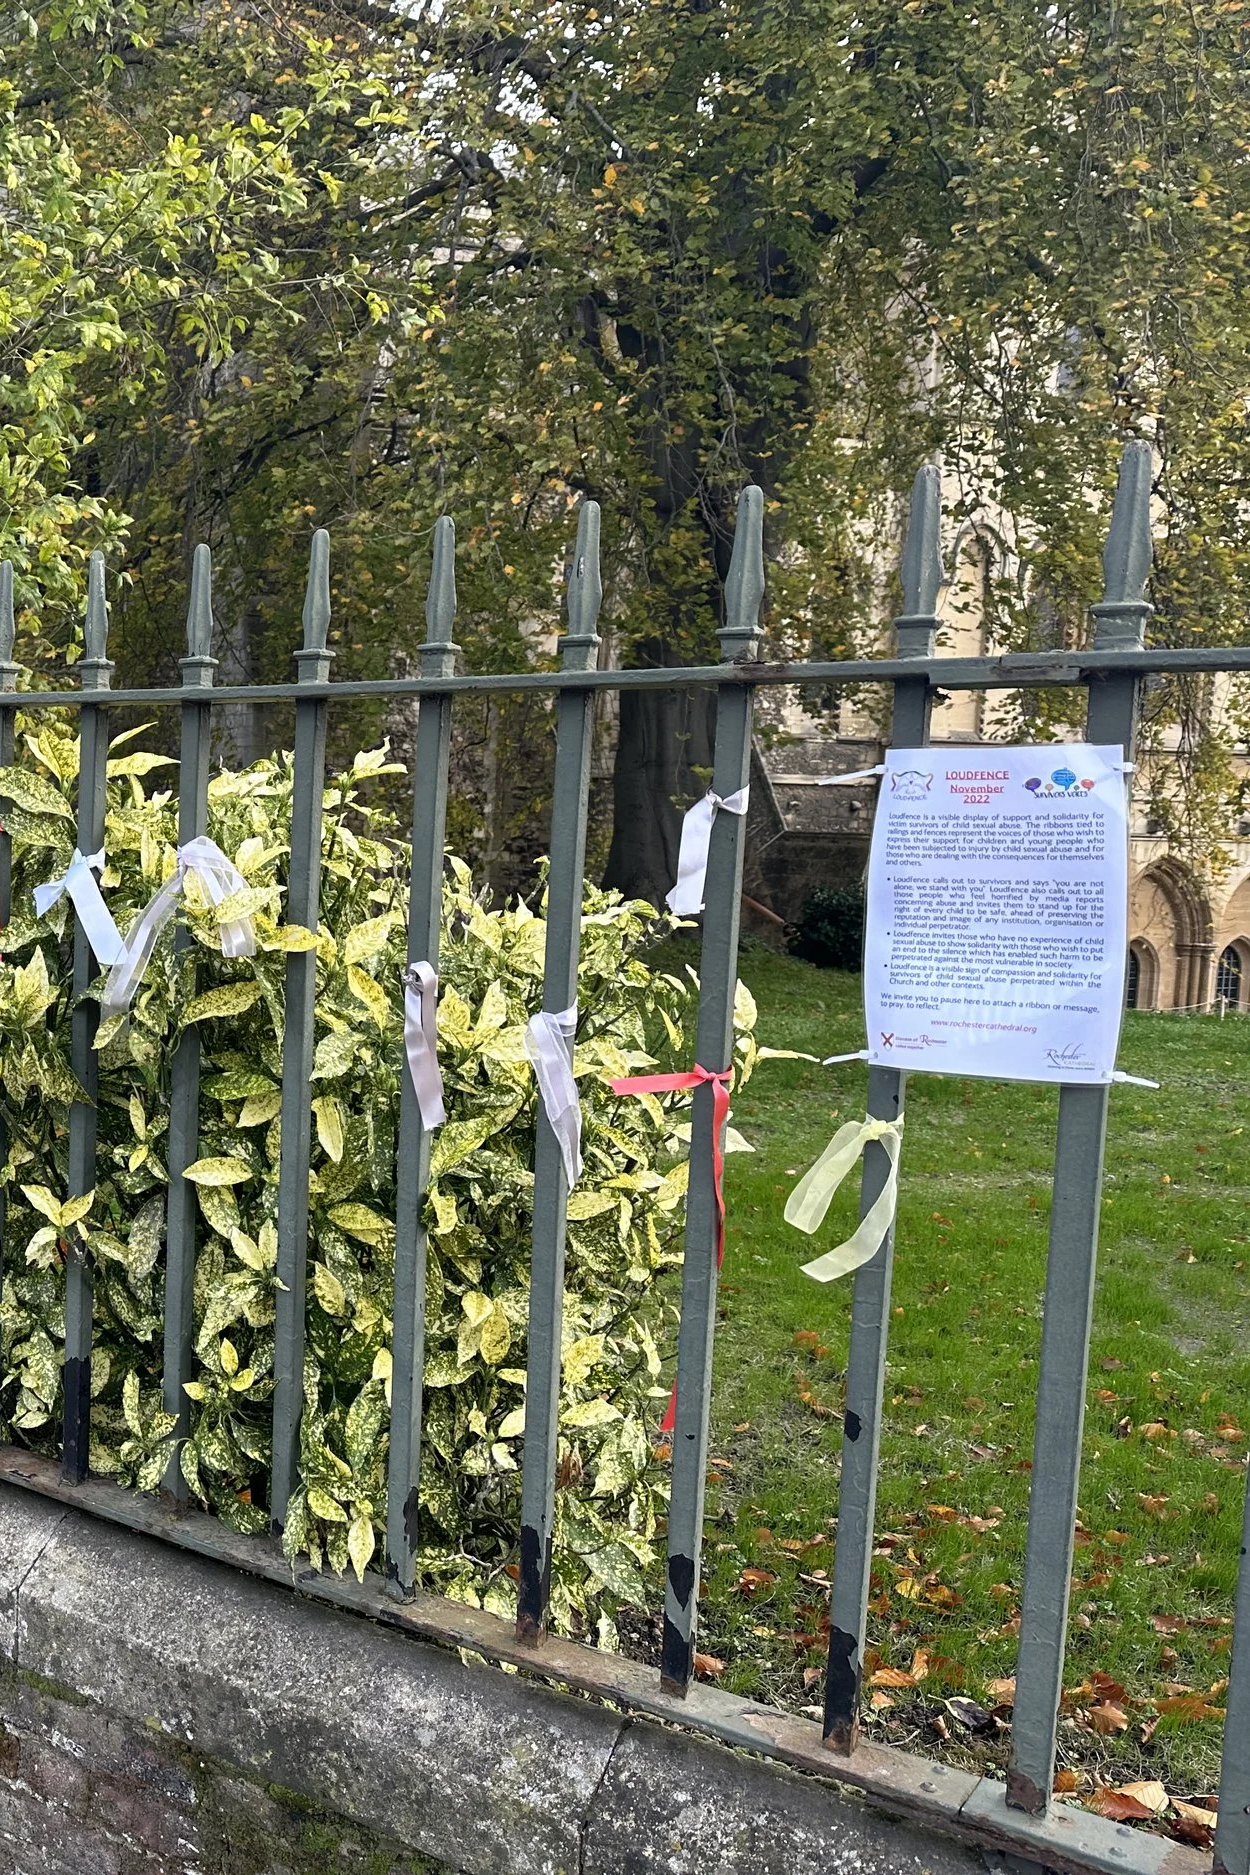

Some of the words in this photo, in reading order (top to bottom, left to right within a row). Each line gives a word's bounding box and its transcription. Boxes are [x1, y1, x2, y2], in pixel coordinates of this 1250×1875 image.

[945, 770, 1010, 780] LOUDFENCE
[950, 784, 1004, 793] November
[963, 794, 991, 804] 2022
[889, 812, 921, 820] Loudfence
[963, 813, 988, 822] display
[991, 813, 1000, 821] of
[1002, 814, 1031, 822] support
[1053, 812, 1089, 821] solidarity
[972, 821, 996, 829] sexual
[1077, 820, 1092, 828] tied
[932, 837, 959, 845] support
[1010, 837, 1024, 845] and
[1056, 837, 1083, 846] people
[1087, 836, 1104, 844] who
[887, 842, 901, 850] have
[922, 844, 956, 853] subjected
[968, 845, 989, 854] injury
[991, 845, 1001, 854] by
[1023, 845, 1047, 853] sexual
[1092, 844, 1104, 852] for
[886, 850, 904, 858] those
[934, 852, 960, 861] dealing
[961, 852, 976, 860] with
[979, 852, 991, 860] the
[893, 875, 930, 883] Loudfence
[933, 876, 948, 884] calls
[894, 890, 913, 898] those
[919, 891, 943, 900] people
[949, 891, 965, 899] who
[991, 892, 1023, 900] horrified
[1029, 894, 1039, 903] by
[894, 899, 933, 907] concerning
[959, 899, 973, 907] and
[976, 900, 1000, 908] invites
[1038, 902, 1059, 910] stand
[1075, 903, 1087, 911] for
[950, 915, 971, 923] image
[974, 915, 982, 923] of
[1044, 919, 1092, 927] organisation
[893, 930, 930, 938] Loudfence
[957, 932, 978, 940] those
[998, 934, 1016, 942] have
[1030, 937, 1071, 945] experience
[1085, 937, 1104, 945] child
[903, 945, 916, 953] end
[928, 946, 940, 954] the
[942, 947, 967, 955] silence
[916, 938, 937, 946] abuse
[967, 941, 1000, 951] solidarity
[1002, 942, 1019, 950] with
[1020, 943, 1041, 951] those
[1090, 947, 1103, 955] put
[890, 977, 914, 985] Church
[964, 997, 980, 1005] here
[1026, 1001, 1050, 1009] ribbon
[1063, 1005, 1100, 1013] message,
[931, 1020, 1037, 1034] www.rochestercathedral.org
